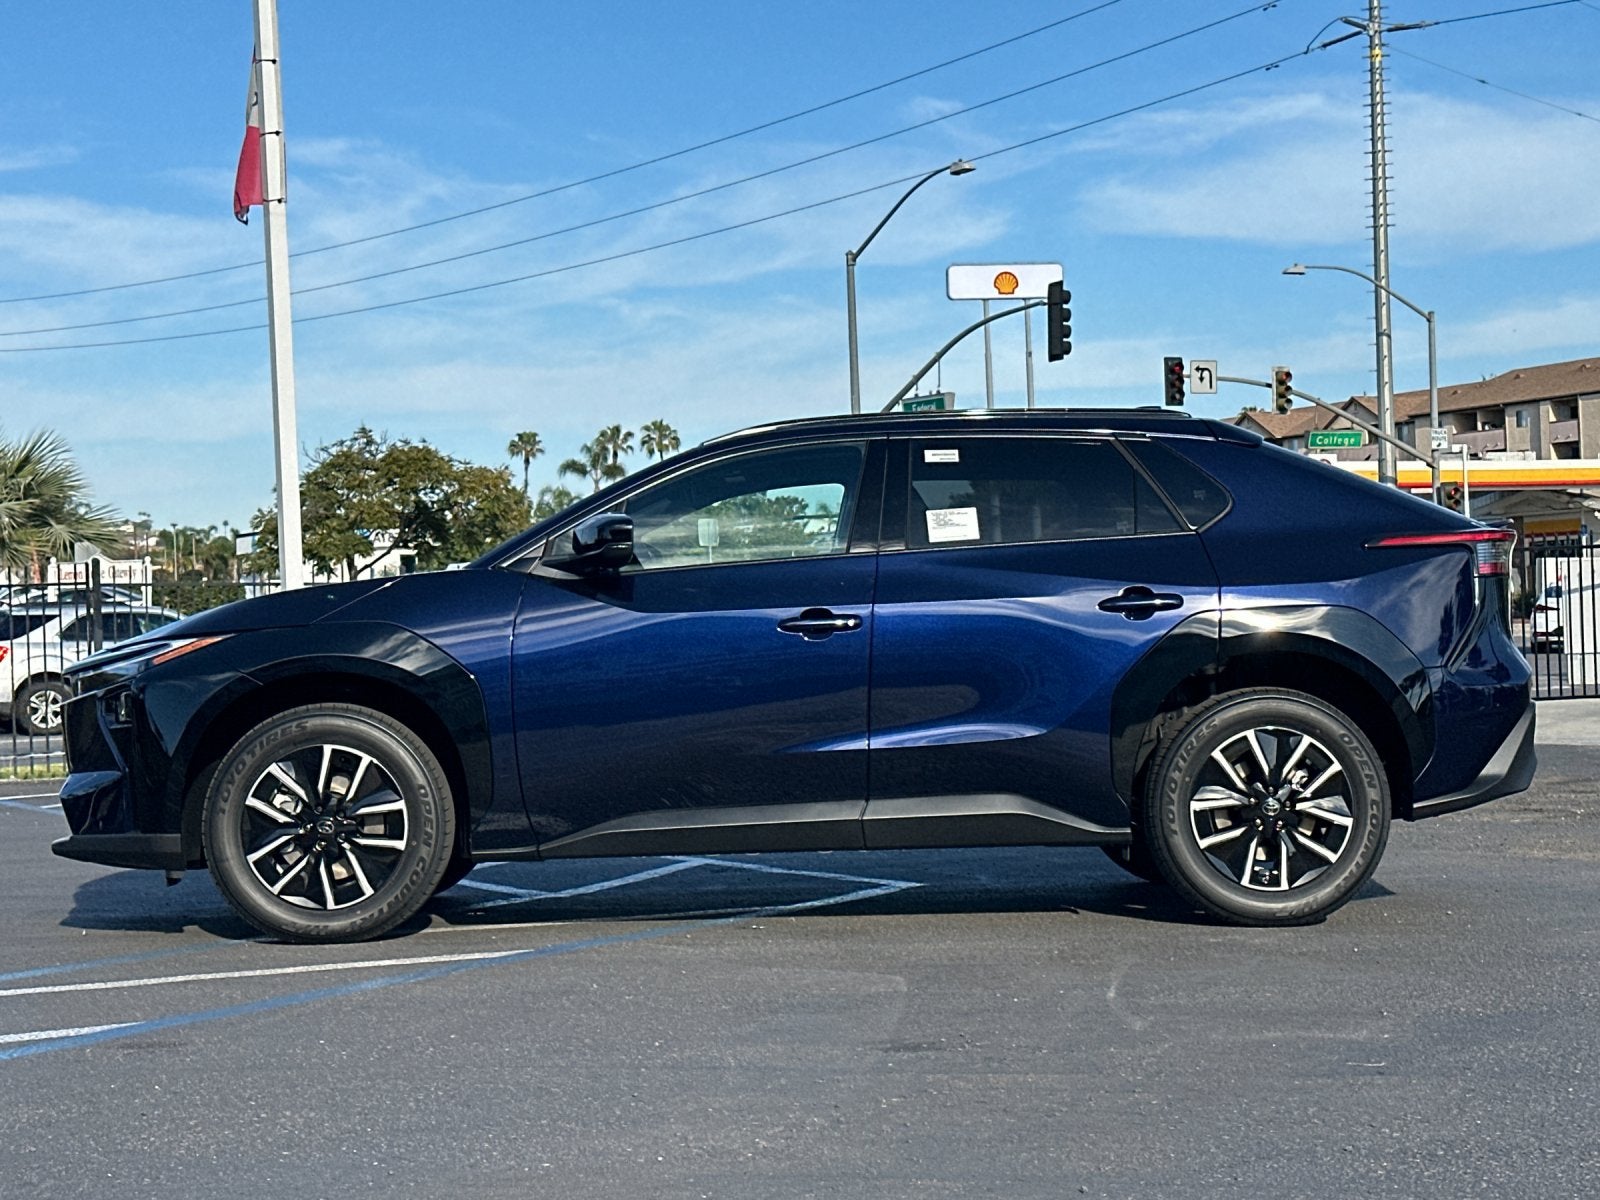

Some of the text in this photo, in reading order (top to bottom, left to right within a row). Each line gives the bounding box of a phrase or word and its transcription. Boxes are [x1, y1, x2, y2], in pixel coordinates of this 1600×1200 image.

[1315, 435, 1356, 447] College
[219, 720, 310, 816] TOYO TIRES
[1172, 718, 1219, 775] TIRES
[1338, 732, 1378, 790] OPEN
[417, 783, 435, 850] OPEN
